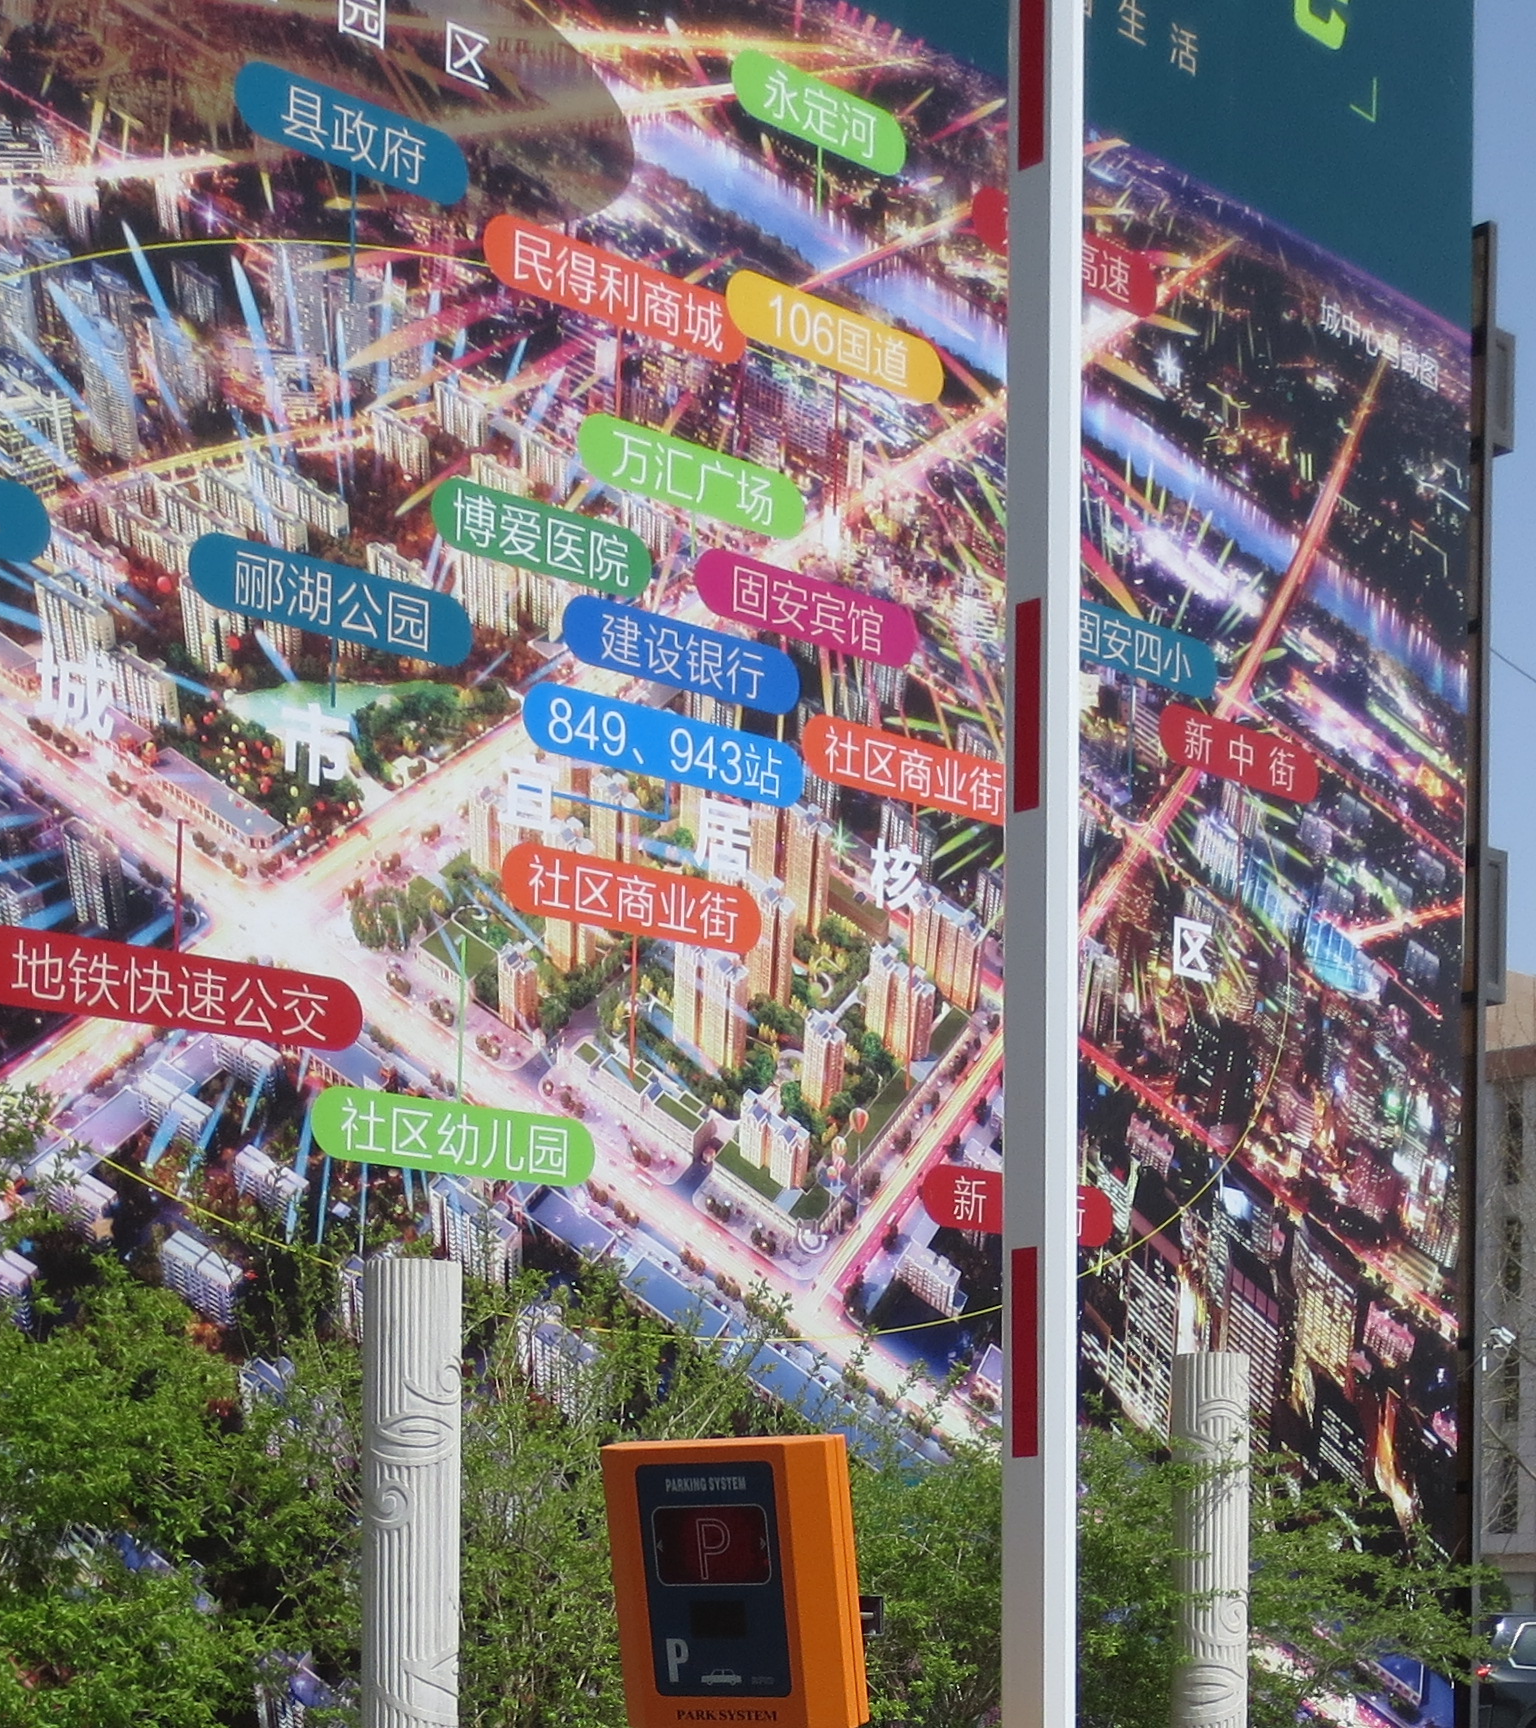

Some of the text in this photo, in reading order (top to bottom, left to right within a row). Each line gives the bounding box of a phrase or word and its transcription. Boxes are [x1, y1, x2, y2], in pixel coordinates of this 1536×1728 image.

[281, 86, 427, 187] 县政府
[762, 69, 877, 160] 永定河
[512, 229, 726, 352] 民得利商城
[767, 293, 910, 389] 106国道
[612, 431, 774, 526] 万汇广场
[452, 488, 631, 587] 博爱医院
[232, 551, 431, 652] 郦湖公园
[730, 566, 884, 656] 固安宾馆
[1078, 608, 1192, 683] 固安四小
[599, 613, 765, 701] 建设银行
[546, 698, 782, 799] 849、943站
[825, 725, 1003, 817] 社区商业街
[1183, 718, 1295, 793] 新中街
[527, 854, 739, 944] 社区商业街
[10, 940, 329, 1043] 地铁快速公交
[339, 1096, 568, 1178] 社区幼儿园
[665, 1476, 747, 1493] PARKING SYSTEM
[665, 1637, 689, 1683] P
[676, 1708, 778, 1722] PARK SYSTEM
